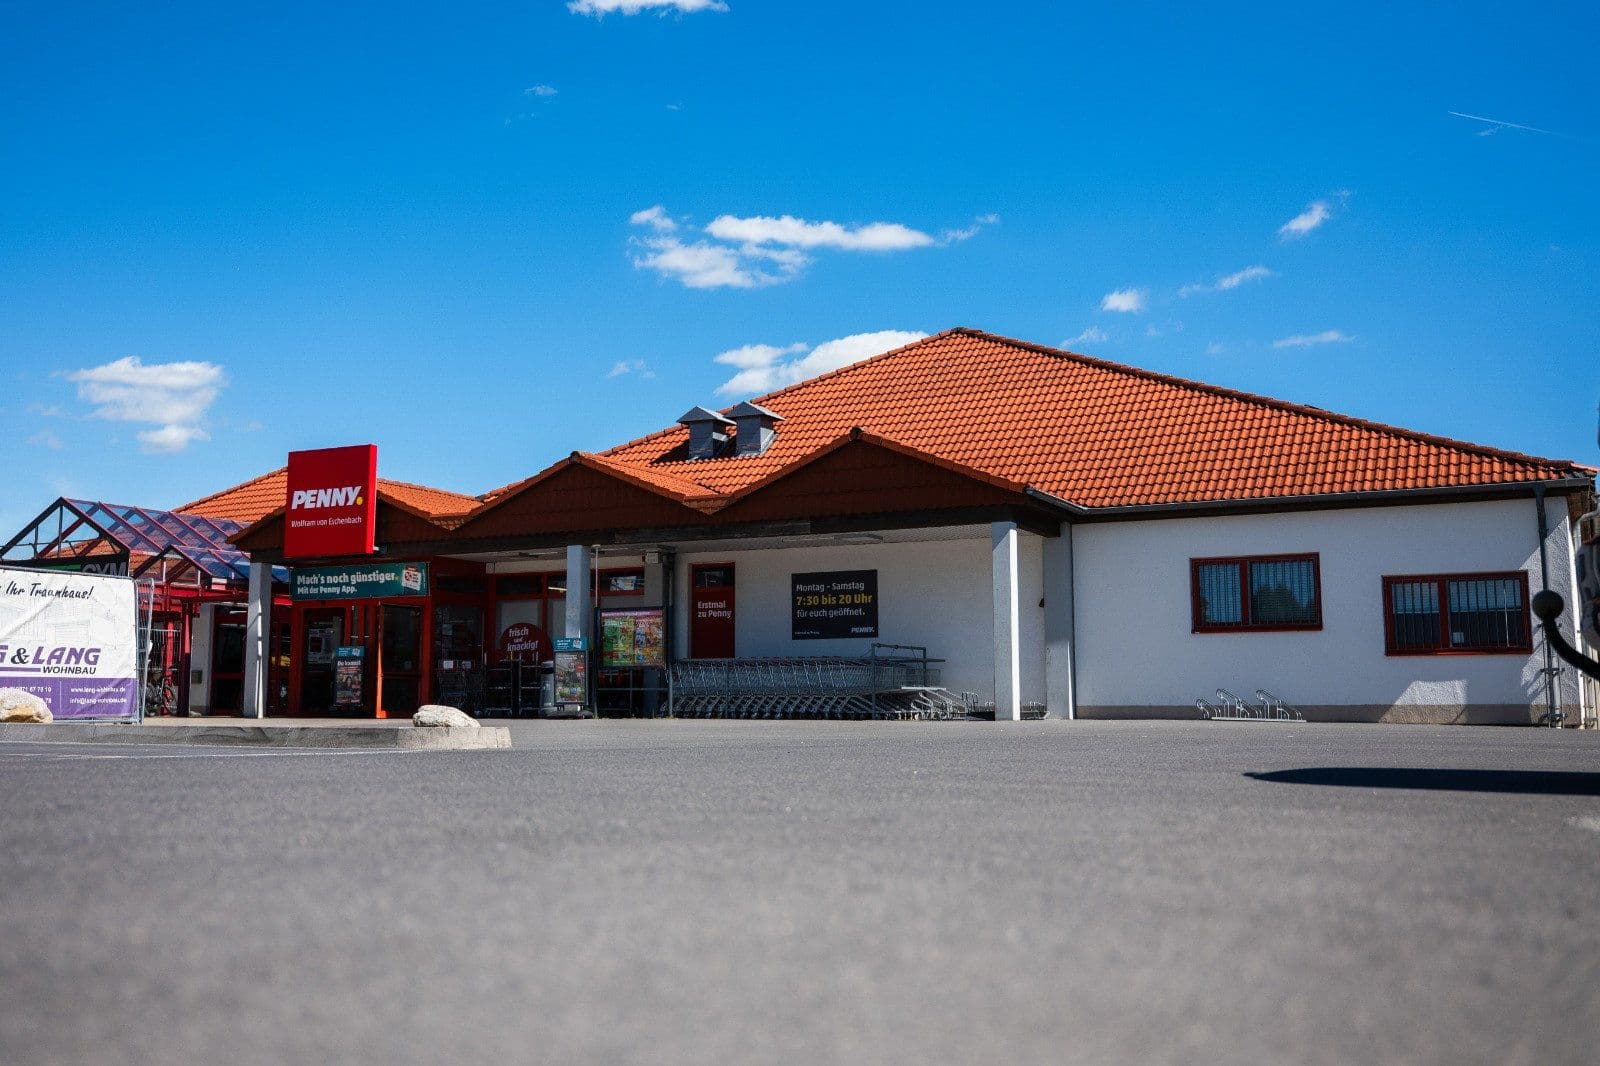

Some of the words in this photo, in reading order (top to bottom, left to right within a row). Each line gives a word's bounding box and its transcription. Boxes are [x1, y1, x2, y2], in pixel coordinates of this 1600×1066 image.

[291, 519, 316, 528] Wolfram
[317, 518, 327, 526] von
[328, 516, 362, 526] Eschenbach
[297, 573, 325, 585] Mach's
[326, 573, 349, 584] noch
[5, 581, 25, 595] Ihr
[30, 582, 95, 600] Traumhaus!
[297, 587, 309, 595] Mit
[320, 586, 341, 595] Penny
[796, 584, 825, 593] Montag
[832, 582, 865, 591] Samstag
[697, 600, 726, 609] Erstmal
[796, 595, 819, 606] 7:30
[821, 593, 837, 605] bis
[838, 594, 851, 604] 20
[854, 593, 873, 604] Uhr
[697, 610, 707, 618] zu
[708, 609, 732, 619] Penny
[797, 609, 807, 618] für
[809, 608, 827, 617] euch
[828, 607, 866, 618] geöffnet.
[10, 647, 30, 665] &
[31, 646, 102, 666] LANG
[42, 666, 97, 675] WOHNBAU
